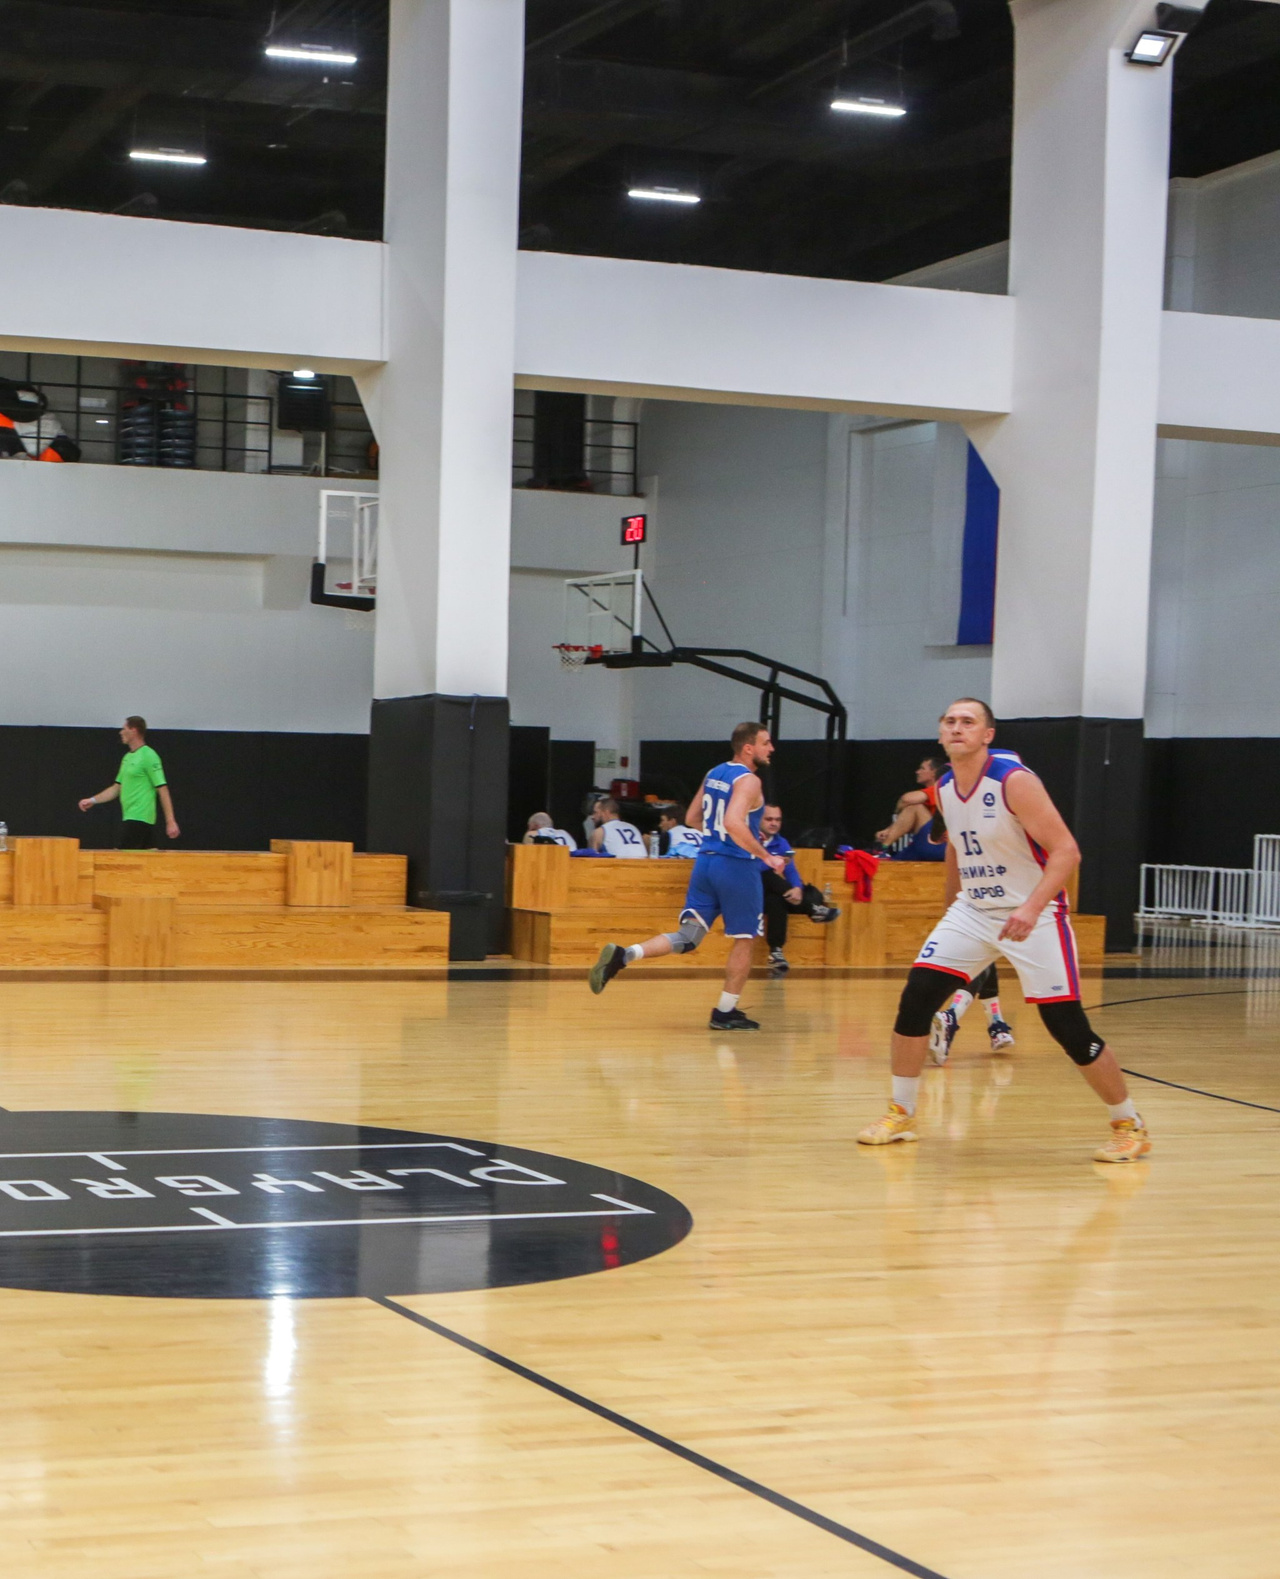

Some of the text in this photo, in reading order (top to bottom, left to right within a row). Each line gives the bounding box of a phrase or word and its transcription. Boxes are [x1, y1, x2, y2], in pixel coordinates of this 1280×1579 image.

[625, 517, 644, 541] 20
[702, 793, 729, 842] 24
[616, 829, 641, 845] 12
[960, 830, 983, 856] 15
[958, 864, 1007, 880] НИИЭФ
[967, 885, 1005, 900] САРОВ
